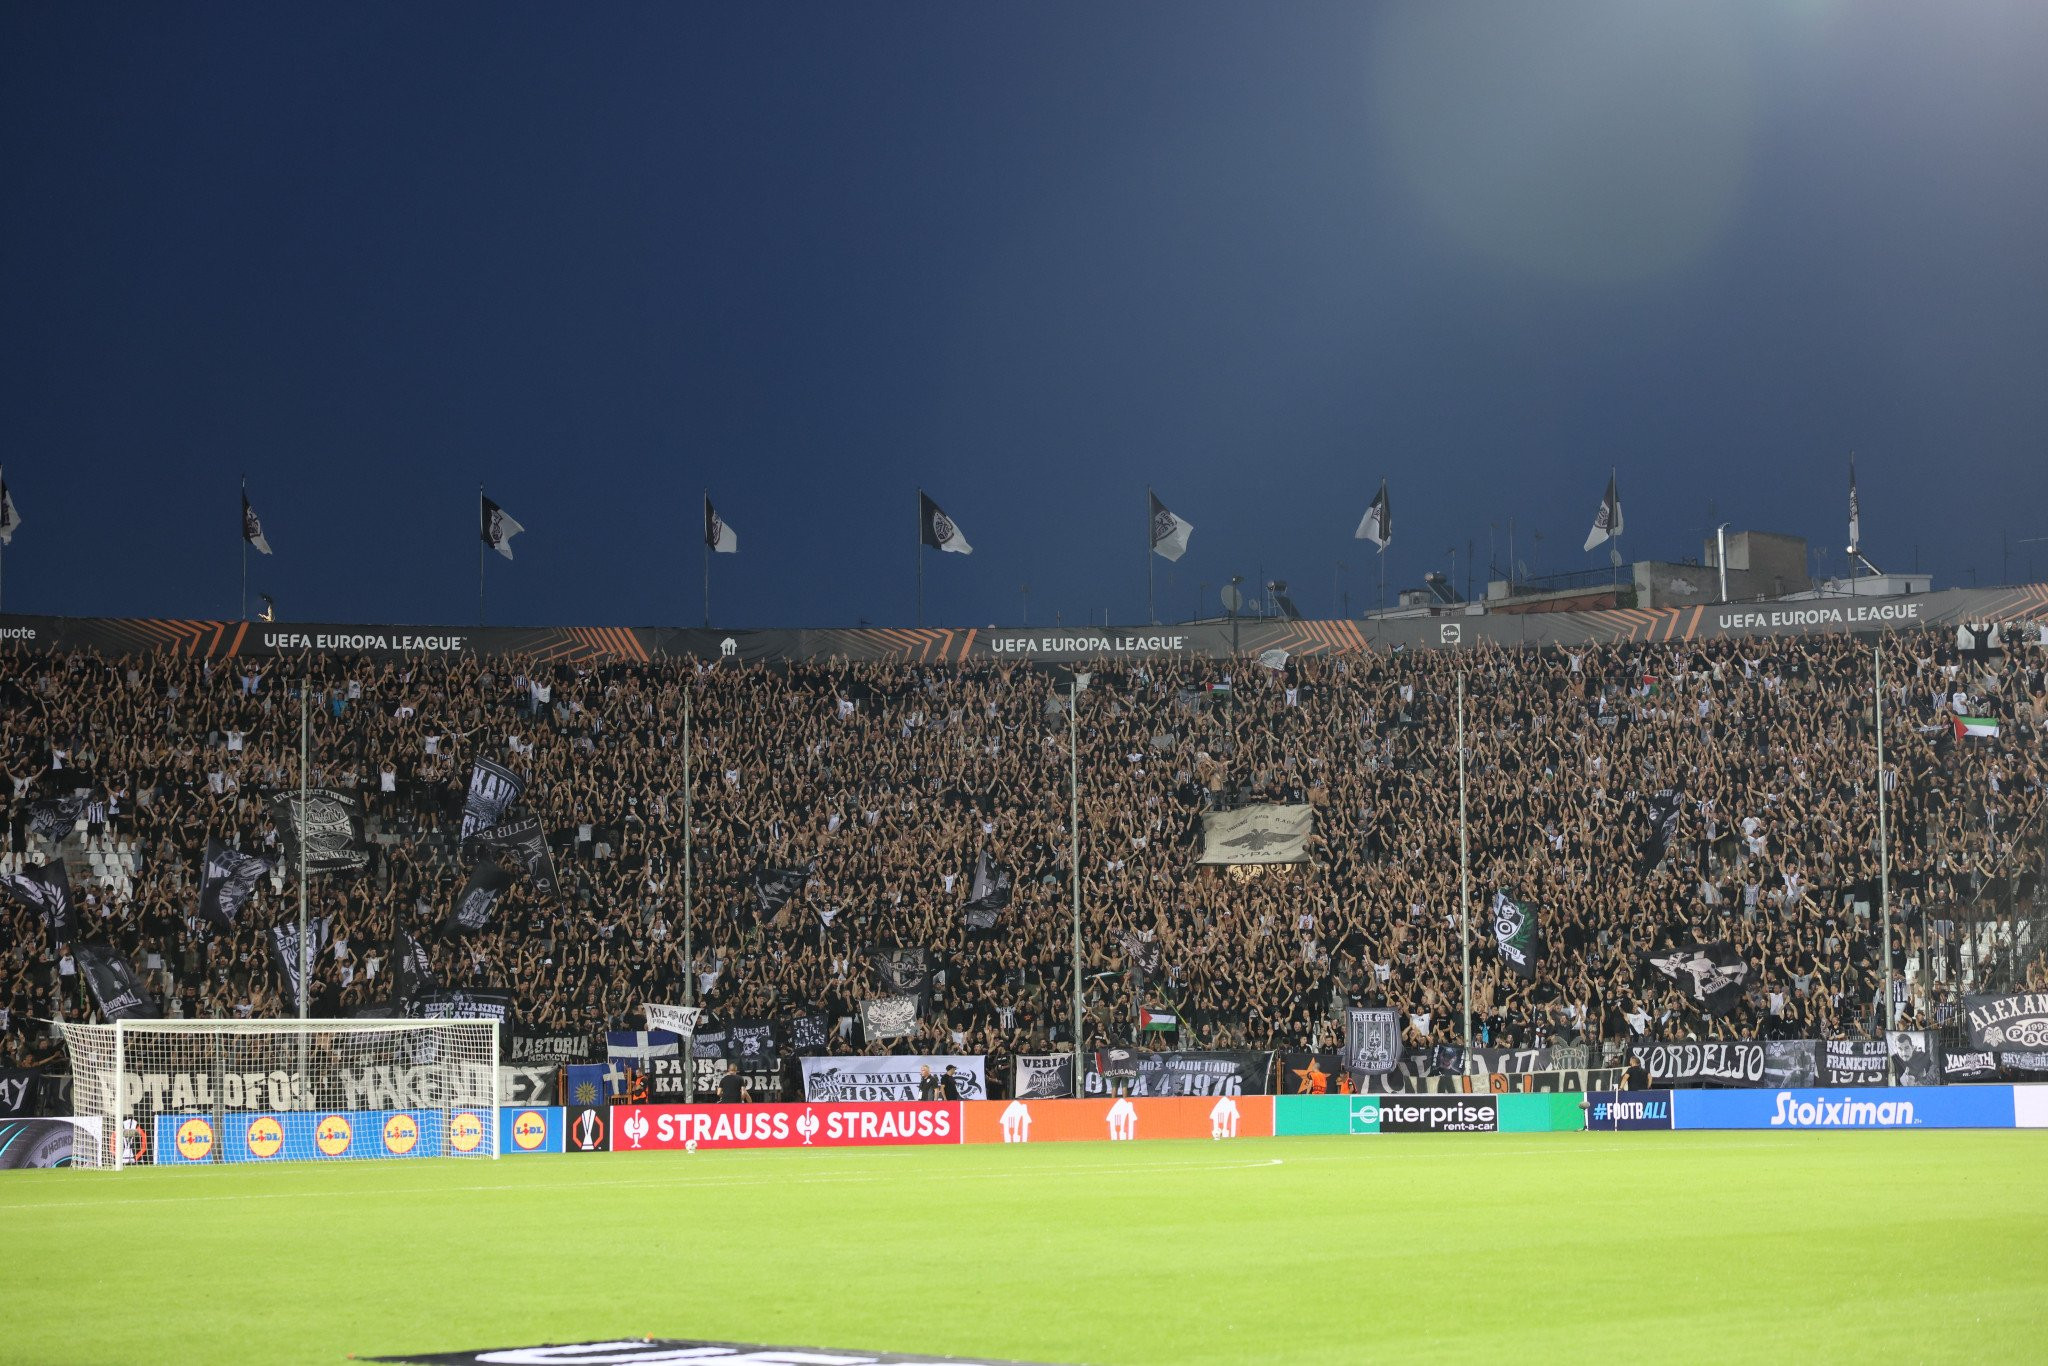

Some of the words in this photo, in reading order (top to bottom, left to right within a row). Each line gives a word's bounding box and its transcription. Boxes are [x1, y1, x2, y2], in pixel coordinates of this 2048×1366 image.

[1720, 614, 1767, 628] UEFA
[1771, 609, 1842, 626] EUROPA
[1847, 604, 1918, 621] LEAGUE
[264, 633, 312, 648] UEFA
[317, 634, 388, 649] EUROPA
[393, 635, 462, 650] LEAGUE
[992, 638, 1038, 652] UEFA
[1042, 637, 1111, 651] EUROPA
[1116, 636, 1183, 650] LEAGUE
[512, 1035, 589, 1059] KASTORIA
[1022, 1057, 1068, 1069] VERIA
[1826, 1054, 1888, 1071] FRANKFURT
[655, 1075, 782, 1092] KASADRA
[1180, 1074, 1242, 1096] 1976
[1354, 1101, 1495, 1127] enterprise
[1593, 1101, 1668, 1120] #FOOTBALL
[1770, 1091, 1914, 1125] Stoiximan
[657, 1112, 789, 1142] STRAUSS
[827, 1110, 951, 1138] STRAUSS
[1443, 1122, 1495, 1131] rent-a-car
